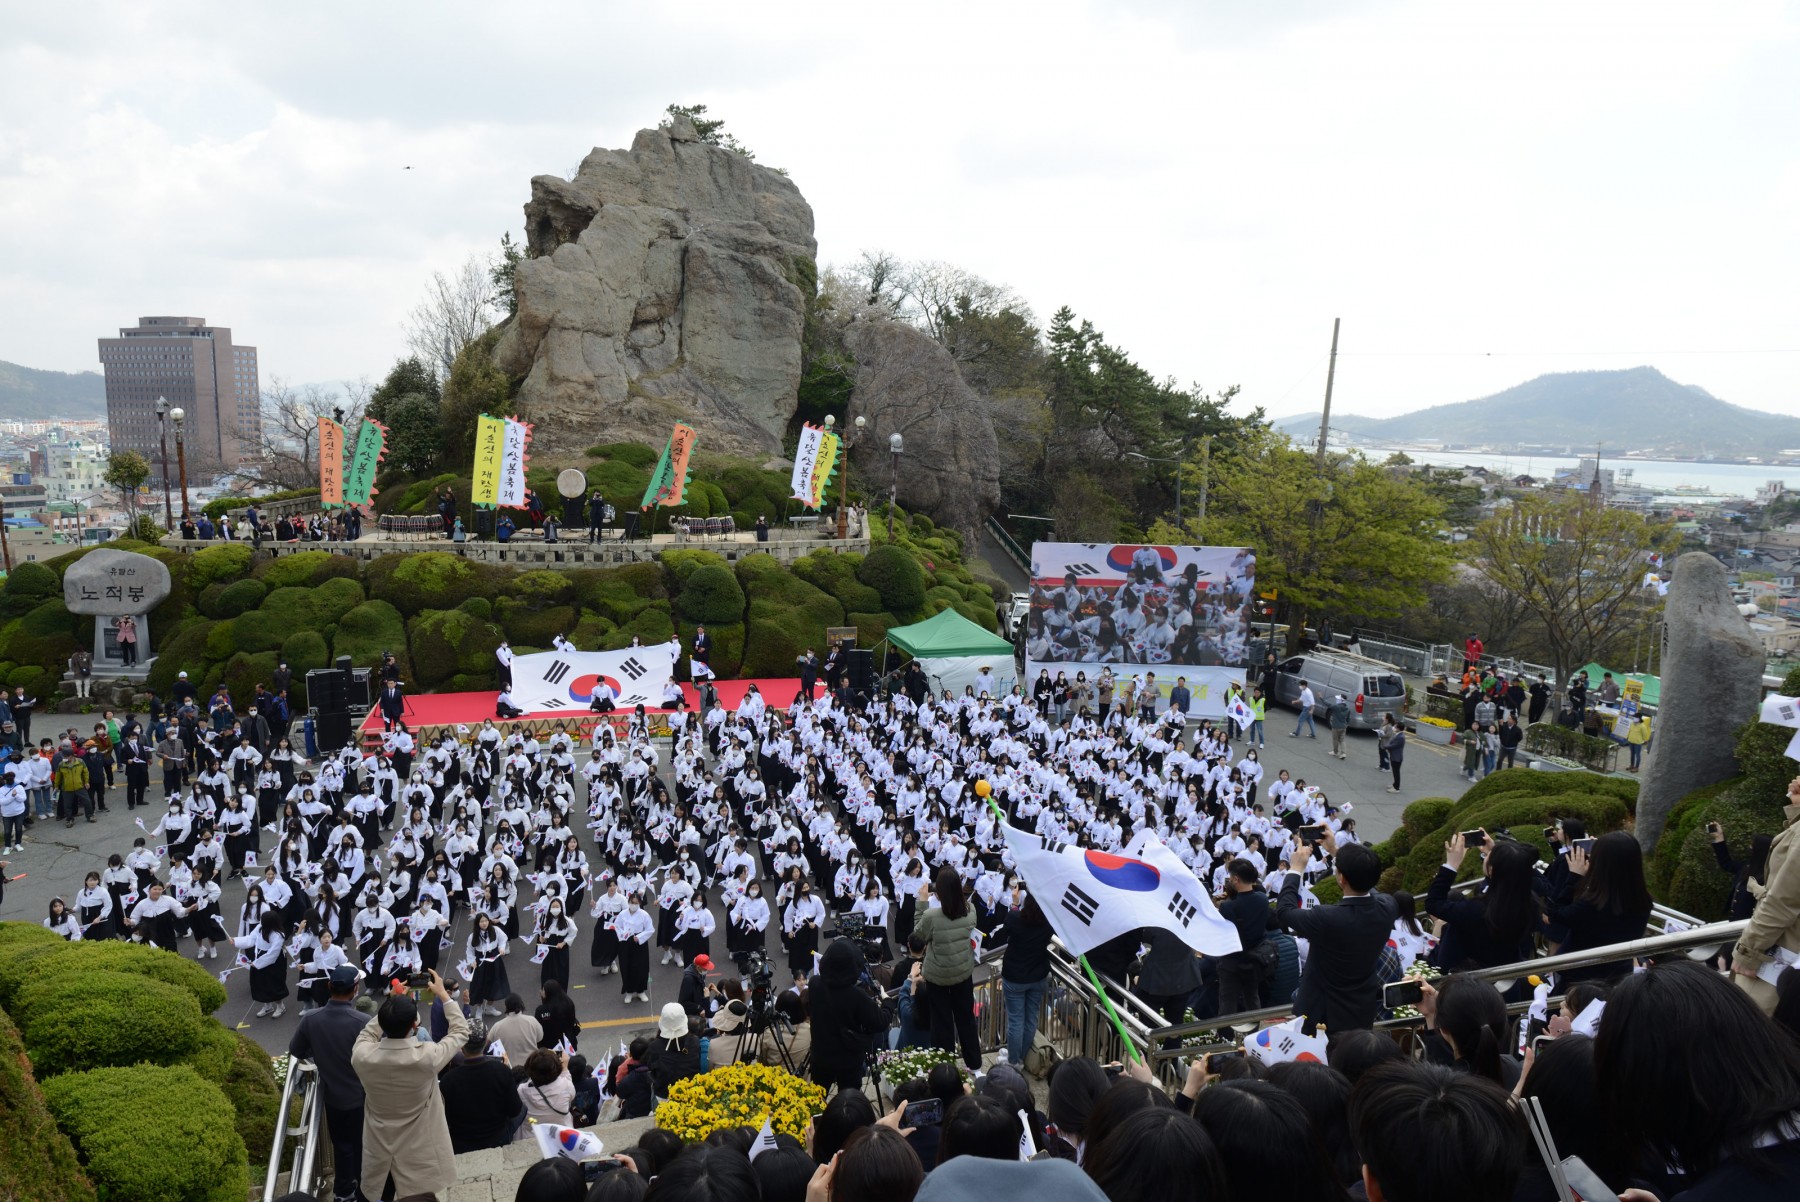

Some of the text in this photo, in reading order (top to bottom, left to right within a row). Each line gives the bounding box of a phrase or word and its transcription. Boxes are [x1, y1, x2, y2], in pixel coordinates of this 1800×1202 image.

[480, 424, 497, 499] 이순신의 재탄생
[109, 567, 136, 576] 유달산
[80, 585, 145, 603] 노적봉
